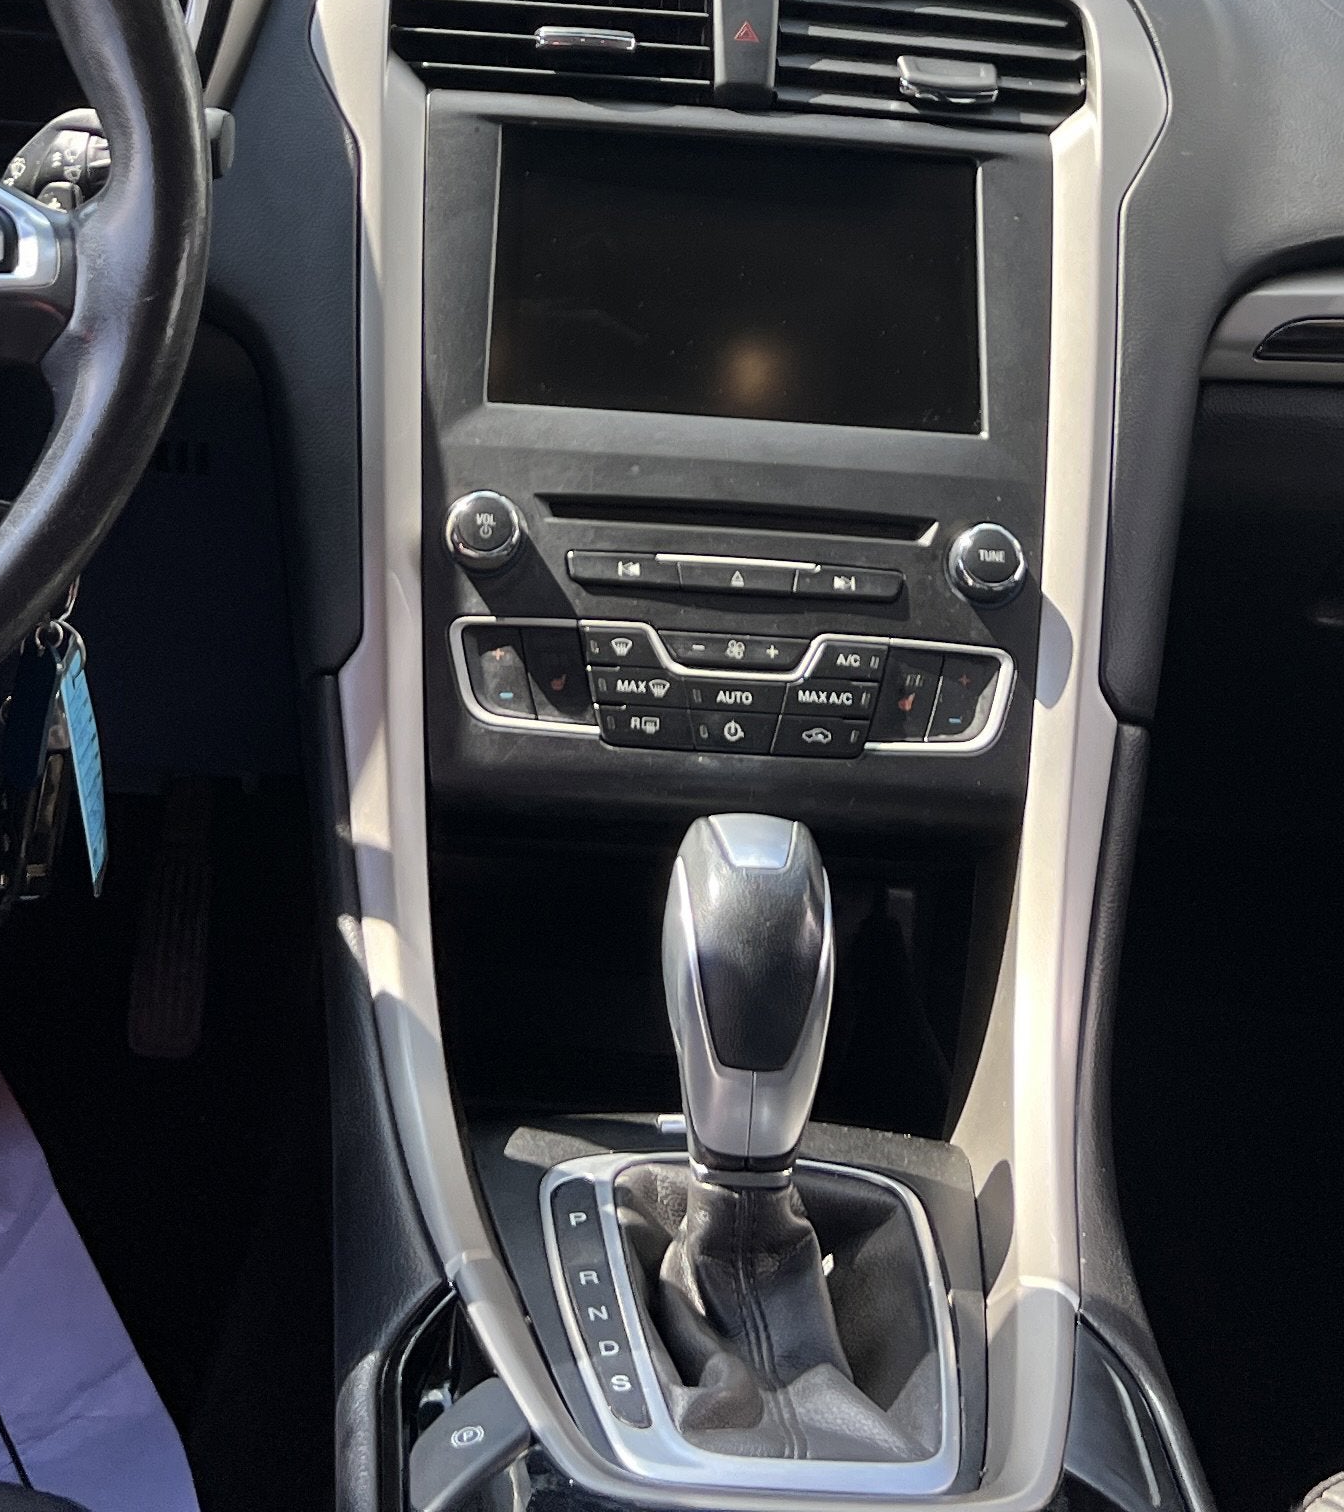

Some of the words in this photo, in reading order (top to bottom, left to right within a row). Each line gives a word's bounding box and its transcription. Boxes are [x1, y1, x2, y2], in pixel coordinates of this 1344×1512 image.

[476, 513, 496, 526] VOL
[978, 549, 1006, 563] TUNE
[836, 653, 861, 668] A/C
[616, 679, 646, 694] MAX
[716, 690, 753, 705] AUTO
[798, 690, 828, 705] MAX
[828, 692, 853, 706] A/C
[569, 1212, 587, 1227] P
[579, 1270, 599, 1286] R
[587, 1305, 608, 1321] N
[598, 1340, 620, 1356] D
[611, 1375, 632, 1392] S
